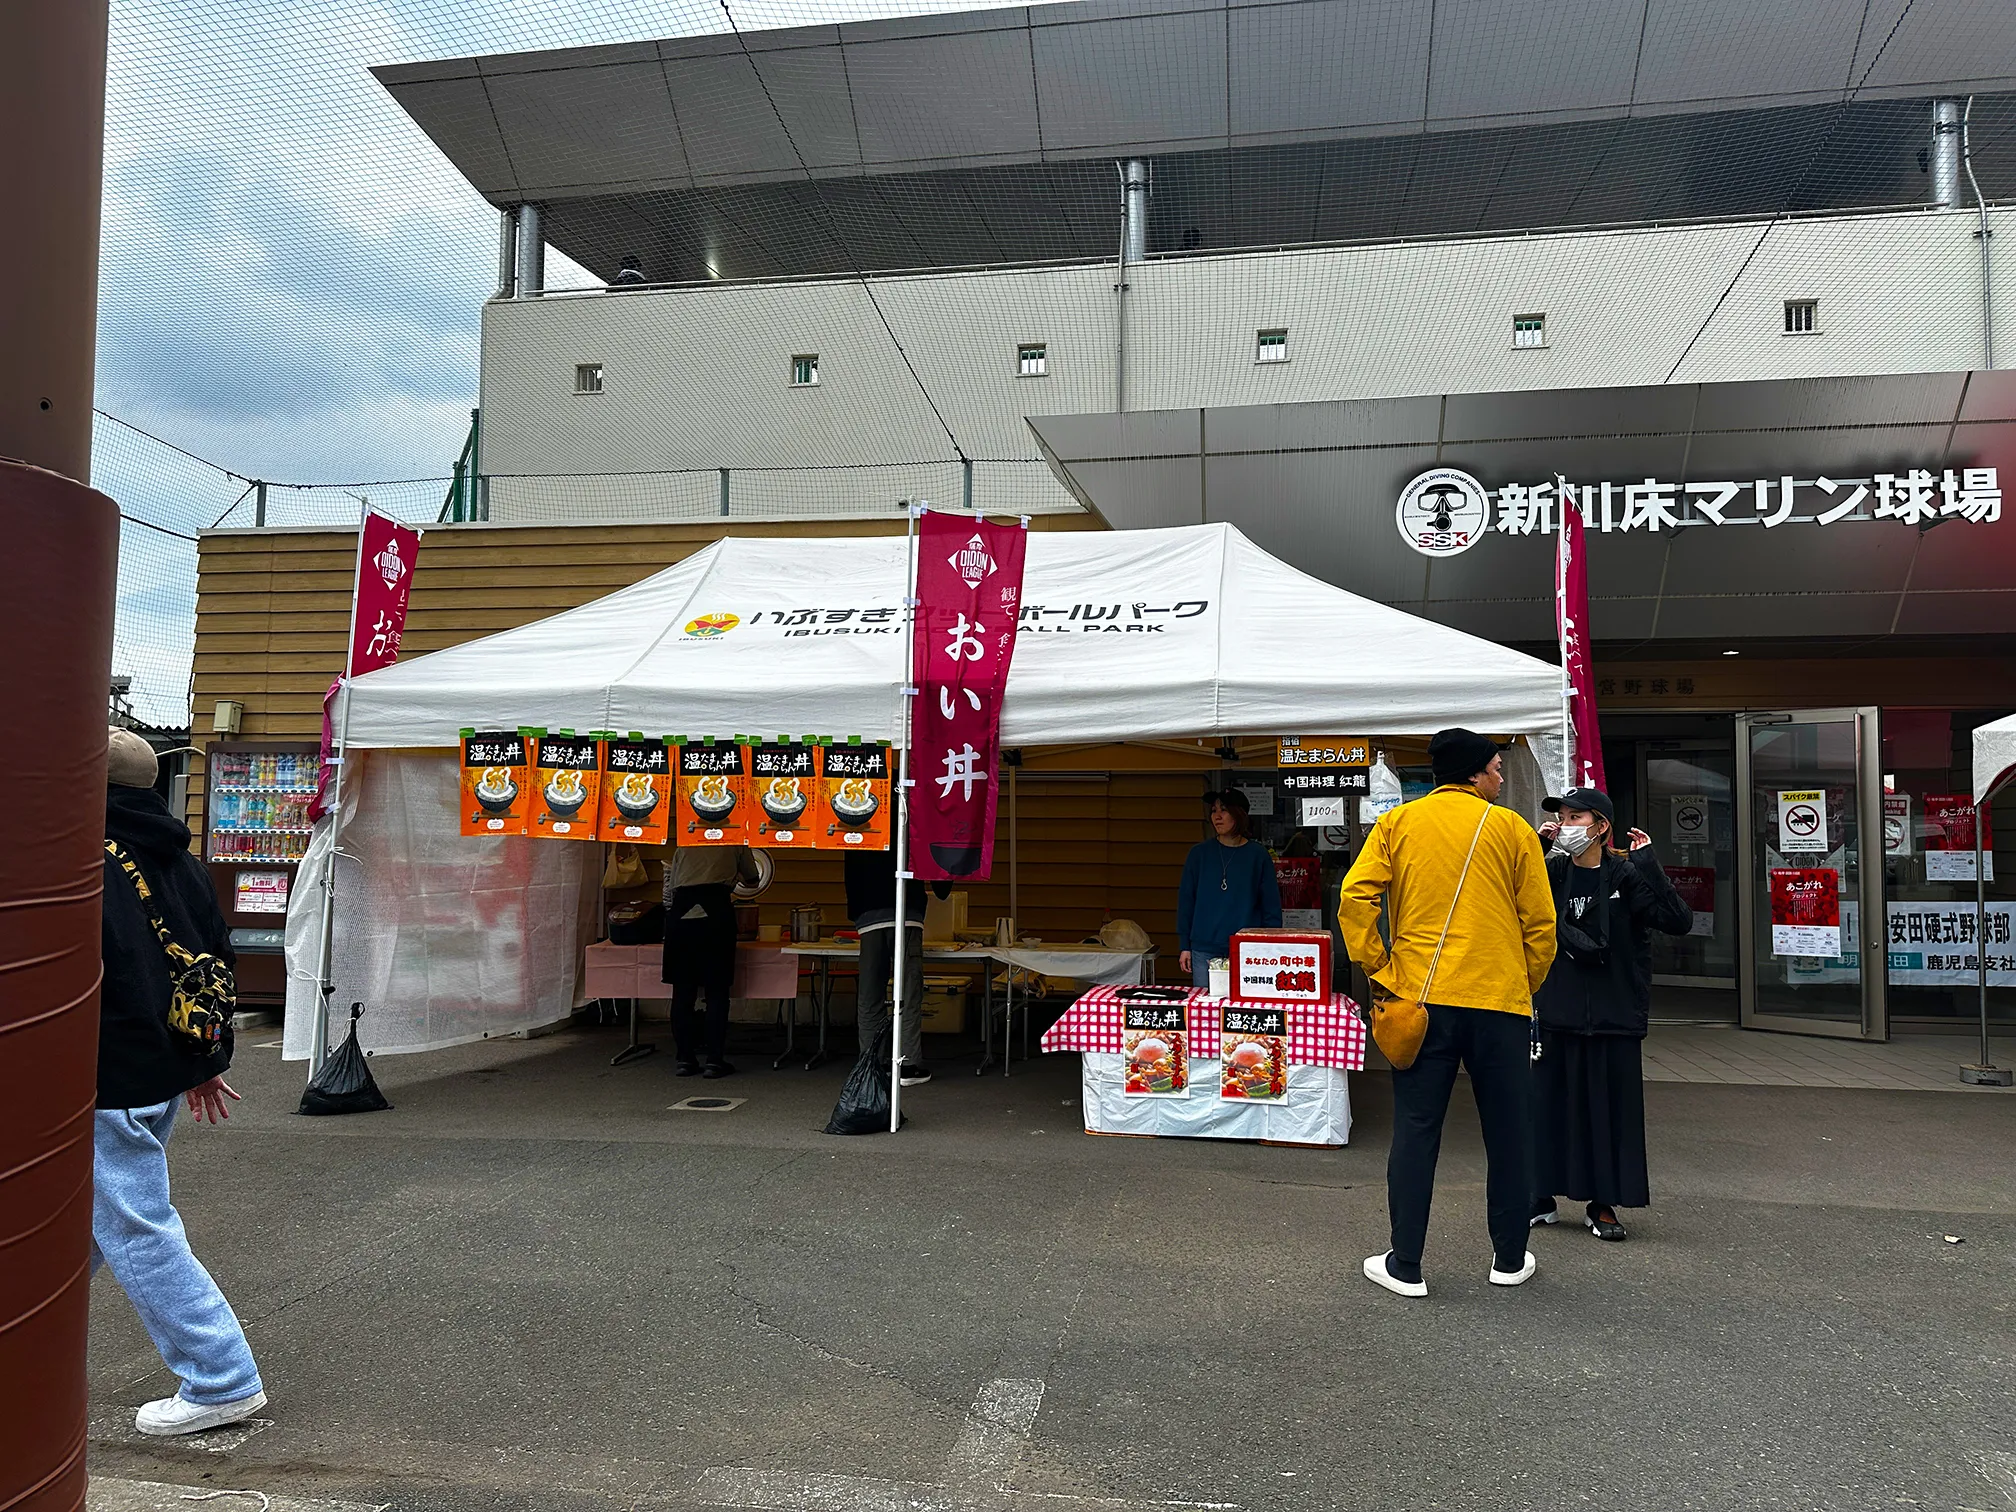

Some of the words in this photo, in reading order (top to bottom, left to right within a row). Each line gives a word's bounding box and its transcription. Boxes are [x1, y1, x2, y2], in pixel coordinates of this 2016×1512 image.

[1406, 478, 1429, 498] GENERAL
[1418, 532, 1468, 547] SSK
[962, 567, 984, 580] LEAGUE
[784, 627, 901, 637] IBUSUKI
[1083, 624, 1165, 633] PARK
[935, 612, 988, 802] おい丼
[1280, 747, 1364, 763] 温たまらん丼
[1283, 775, 1335, 788] 中国料理
[1339, 775, 1367, 788] 紅龍
[1939, 806, 1976, 818] あこがれ
[1276, 868, 1308, 879] あこがれ
[1786, 880, 1823, 891] あこがれ
[1927, 955, 2016, 971] 鹿児島支社
[1243, 975, 1273, 984] 中国料理
